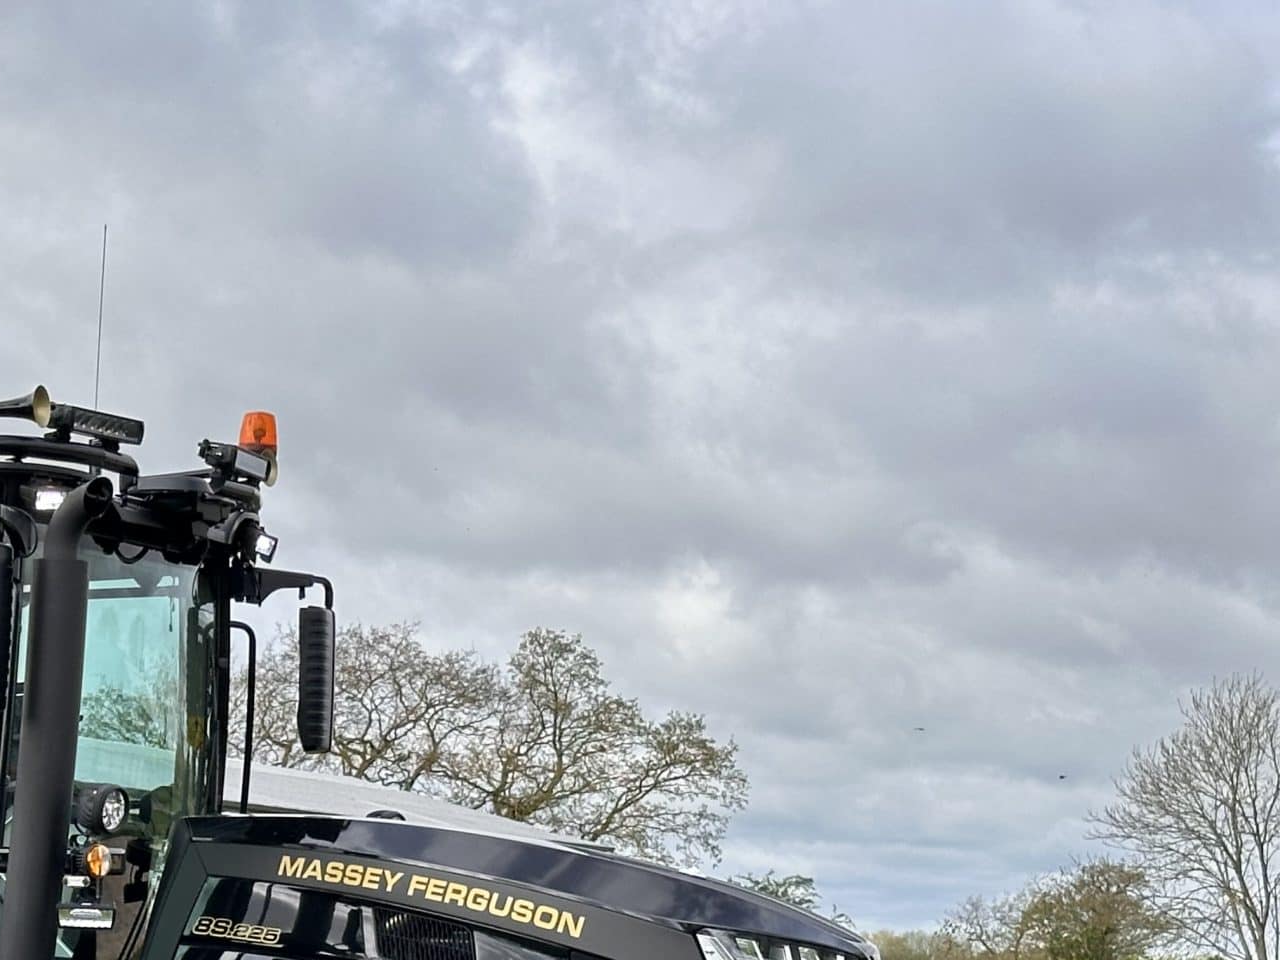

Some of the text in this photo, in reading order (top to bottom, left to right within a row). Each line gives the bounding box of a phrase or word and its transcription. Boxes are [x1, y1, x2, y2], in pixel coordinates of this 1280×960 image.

[278, 855, 586, 938] MASSEY FERGUSON
[192, 916, 281, 944] 8S.225
